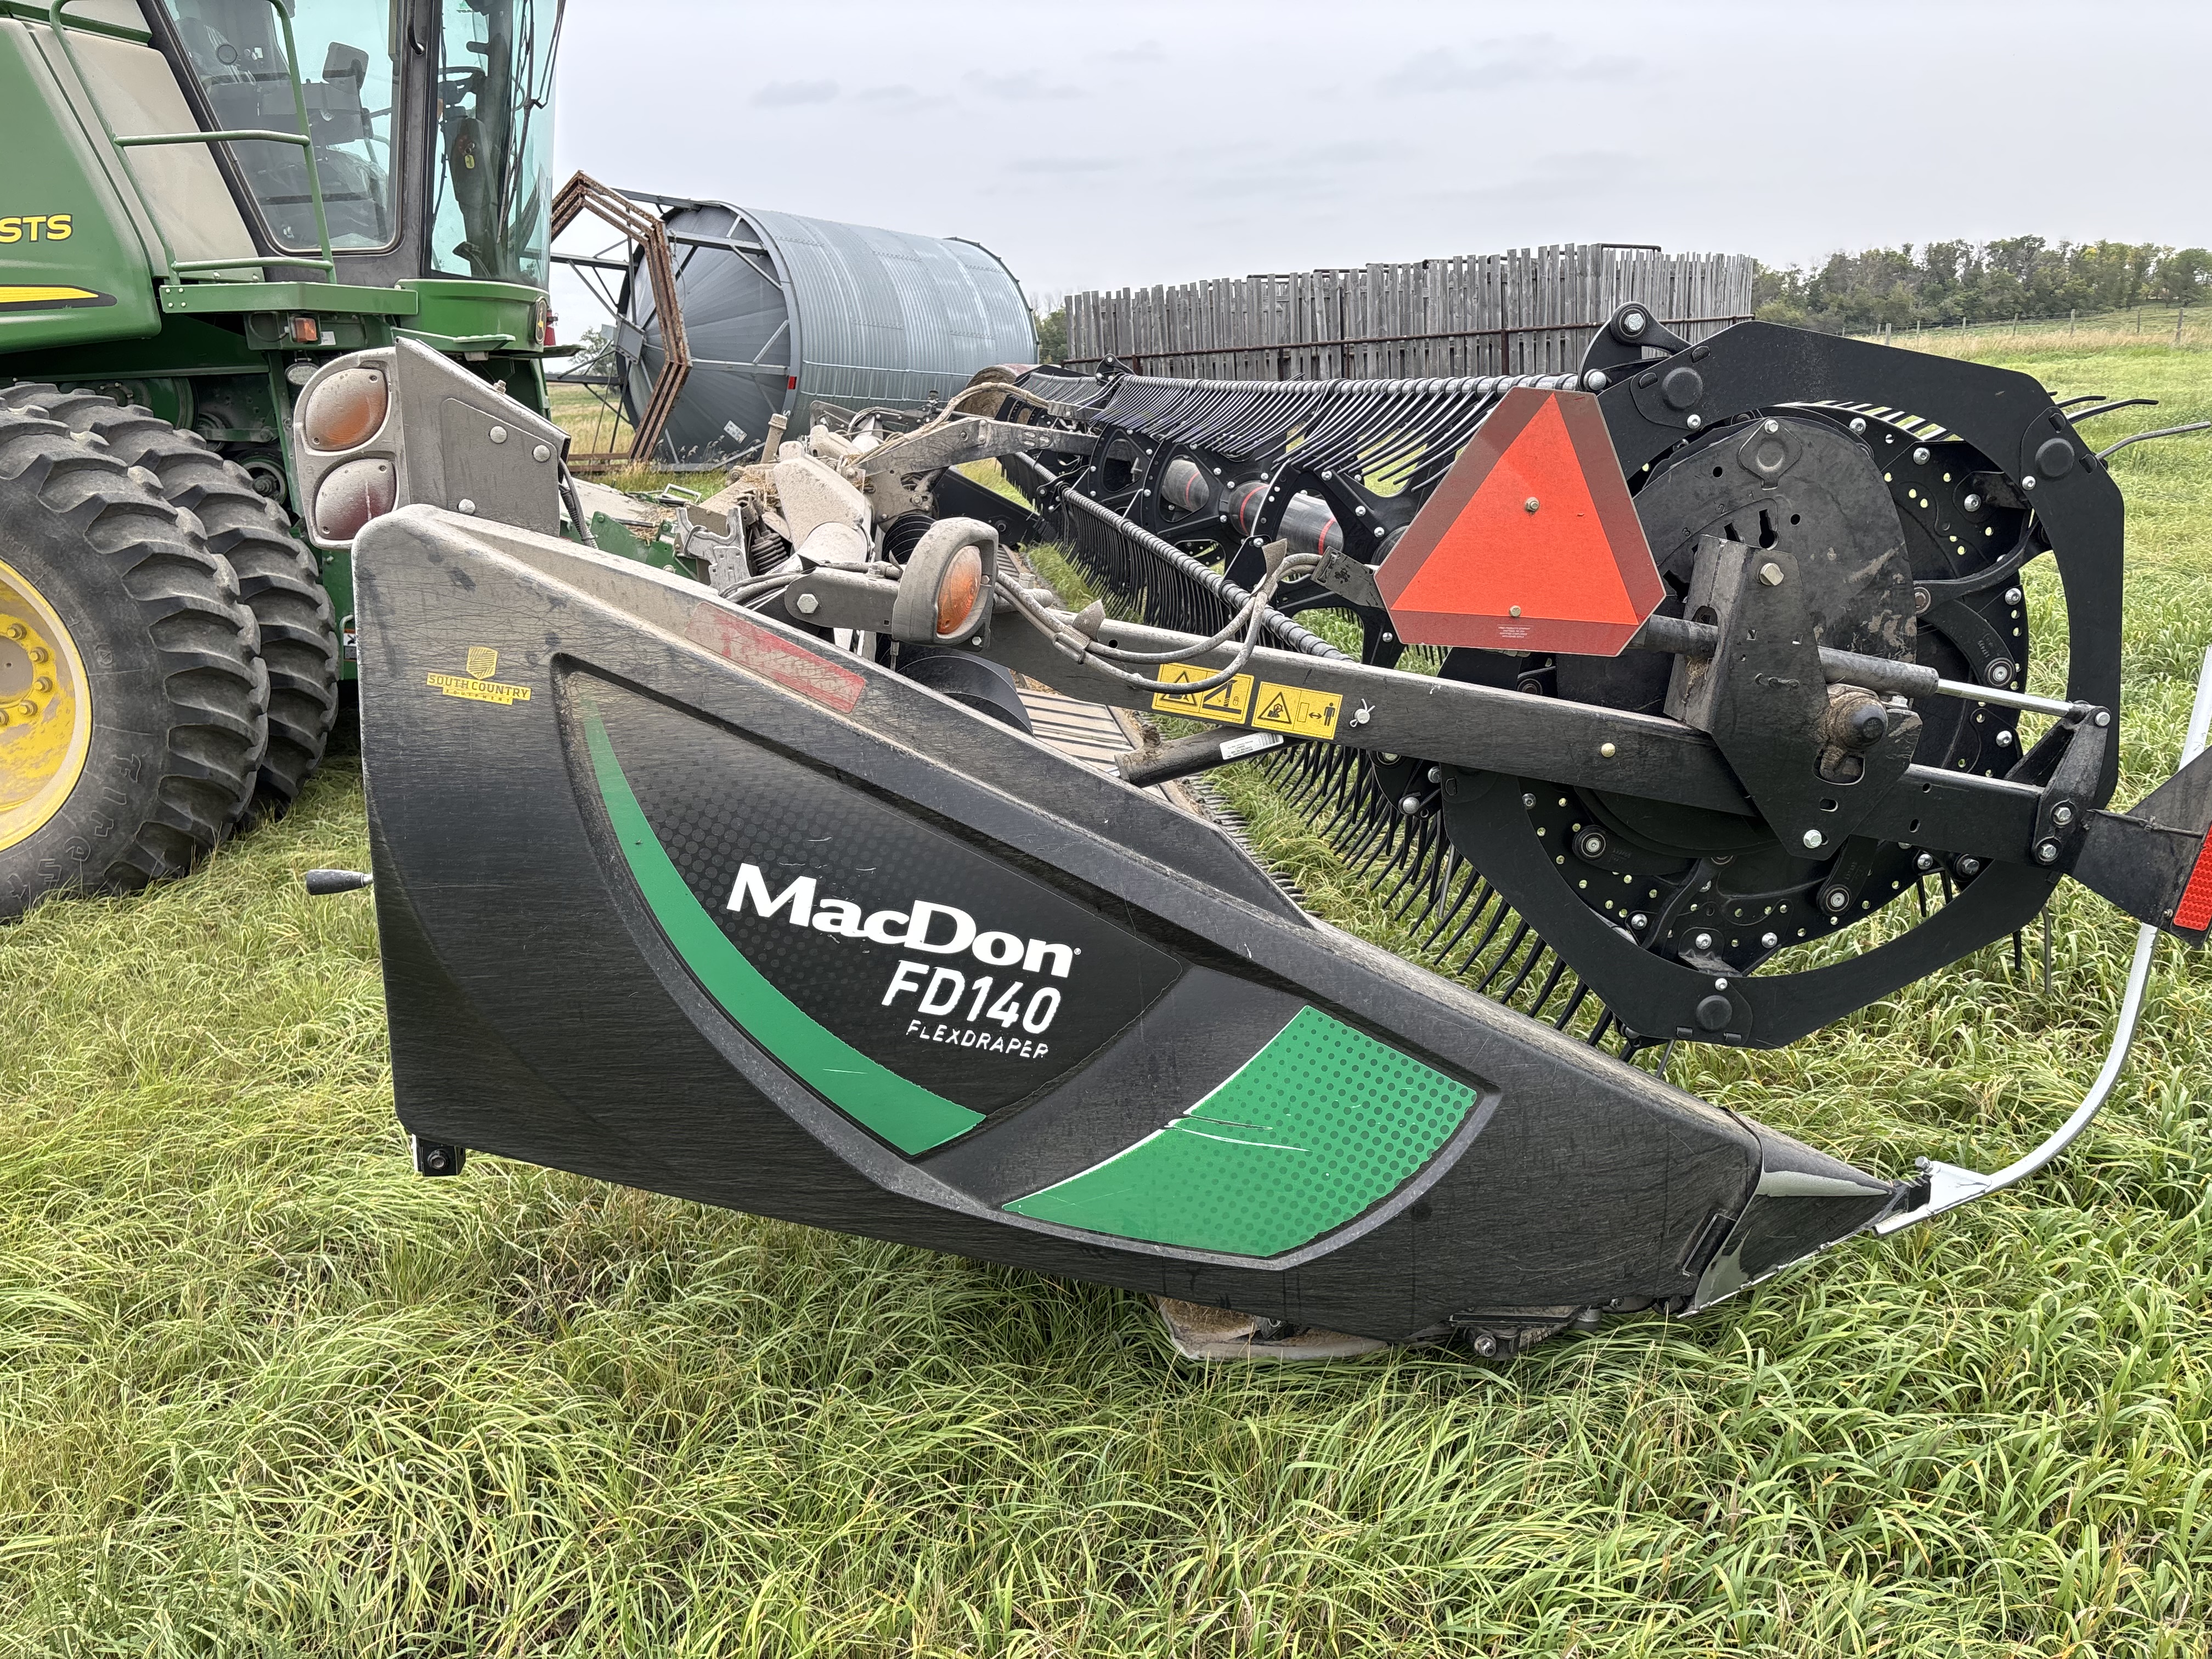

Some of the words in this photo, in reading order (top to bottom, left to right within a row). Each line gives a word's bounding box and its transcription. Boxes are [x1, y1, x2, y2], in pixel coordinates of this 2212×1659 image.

[0, 214, 72, 243] STS
[428, 675, 469, 690] SOUTH
[471, 681, 529, 698] COUNTRY
[446, 689, 510, 703] EQUIPMENT
[727, 862, 1074, 978] MacDon
[881, 960, 1061, 1034] FD140
[905, 1019, 1049, 1059] FLEXDRAPER
